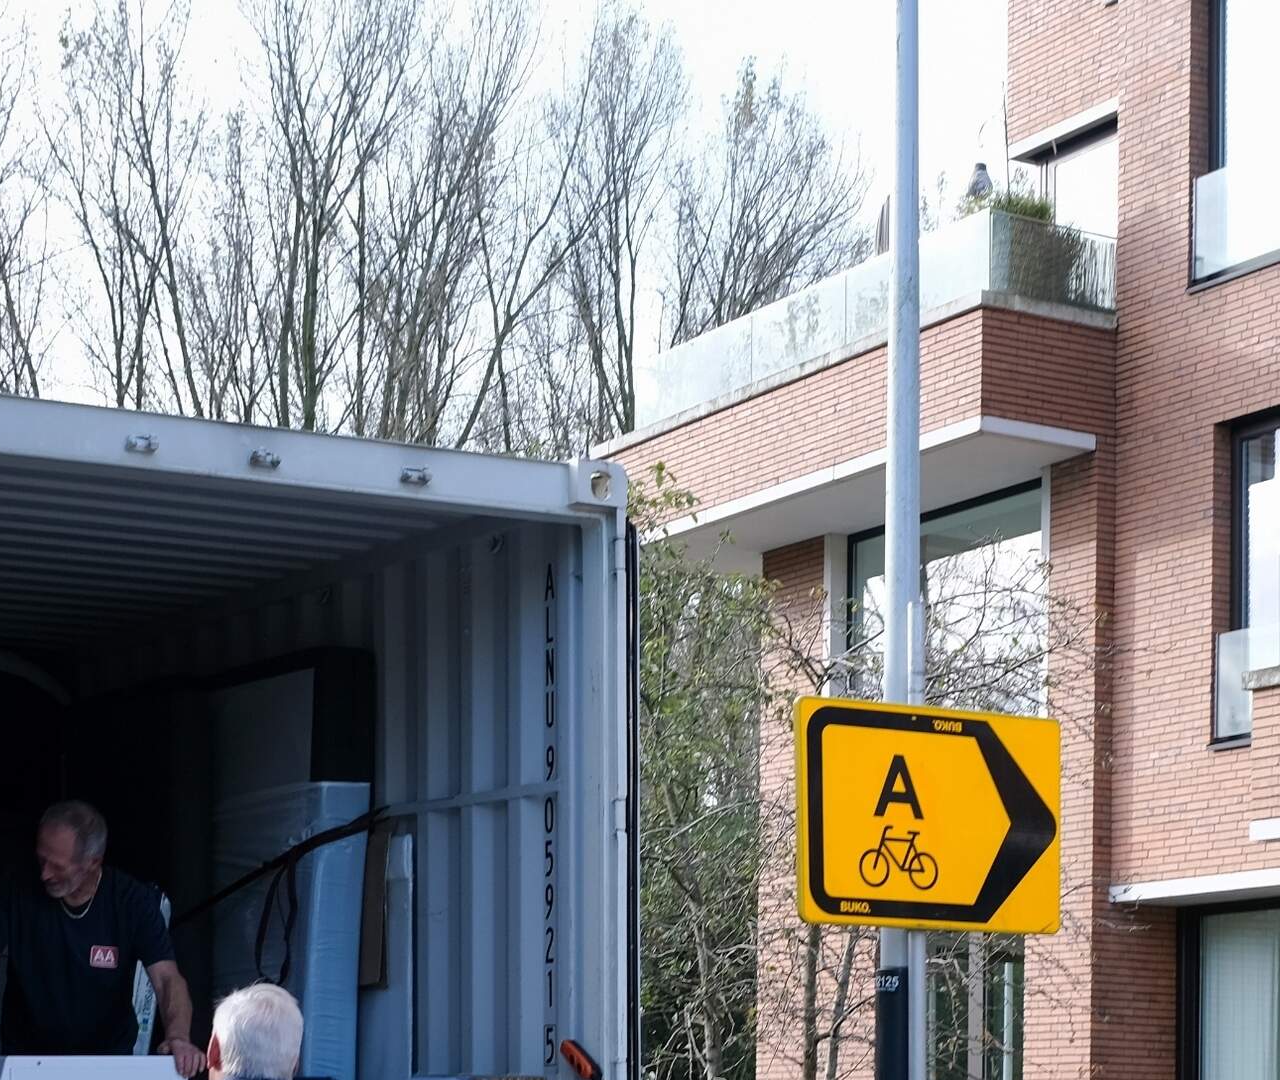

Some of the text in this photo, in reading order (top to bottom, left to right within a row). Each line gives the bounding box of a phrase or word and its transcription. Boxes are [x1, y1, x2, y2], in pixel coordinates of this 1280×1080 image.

[544, 562, 555, 728] ALNU
[873, 754, 924, 820] A
[93, 948, 115, 962] AA
